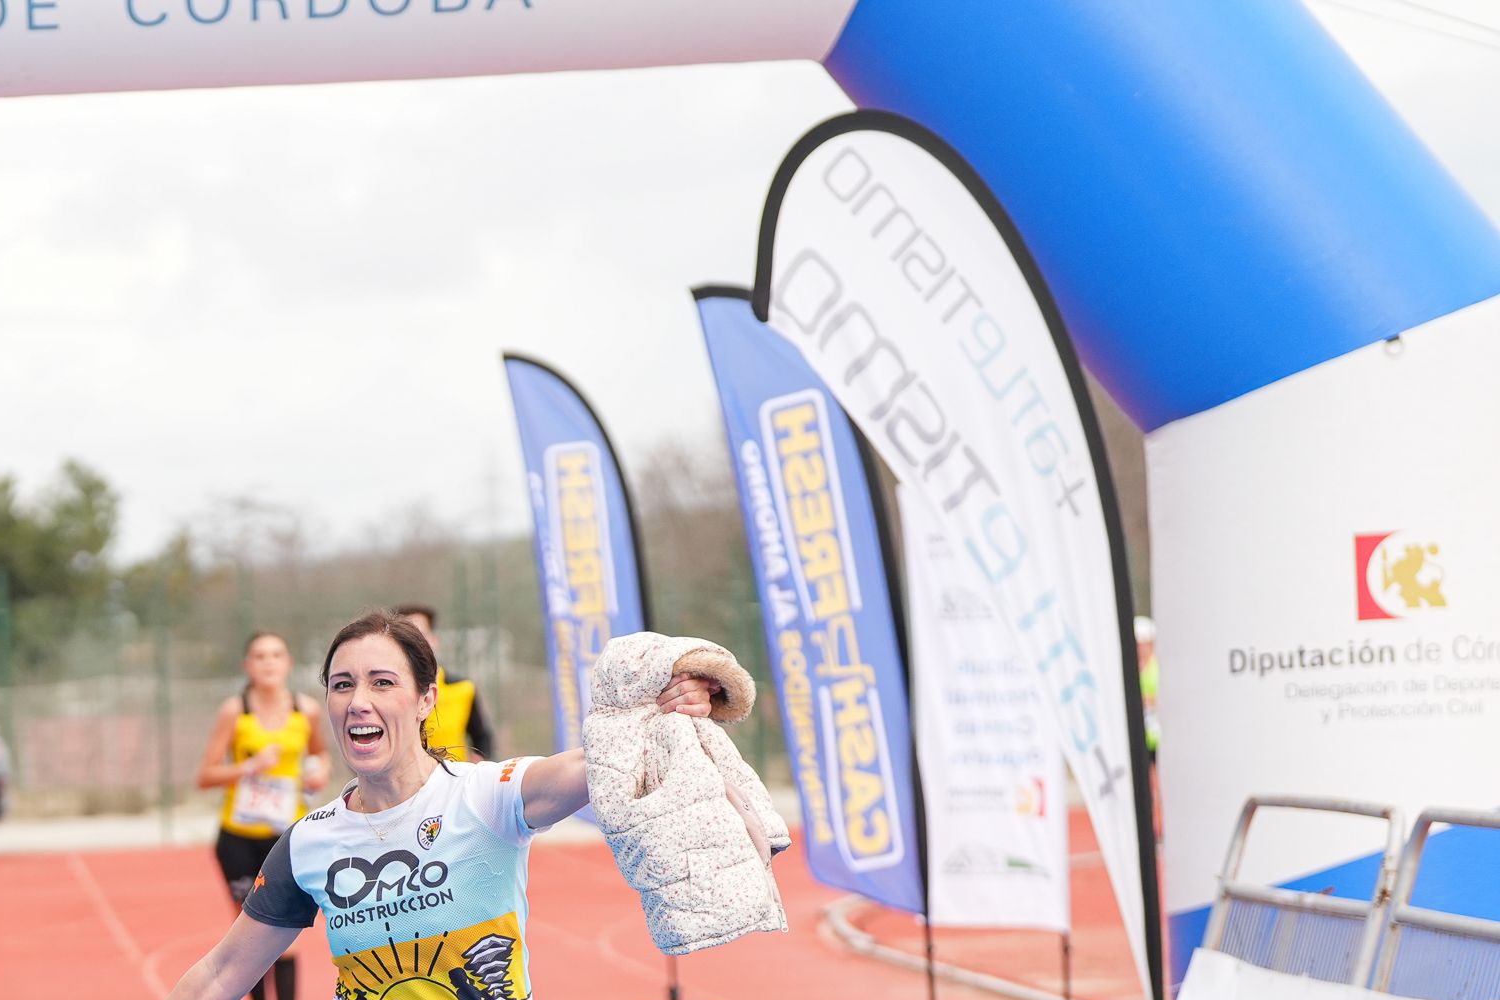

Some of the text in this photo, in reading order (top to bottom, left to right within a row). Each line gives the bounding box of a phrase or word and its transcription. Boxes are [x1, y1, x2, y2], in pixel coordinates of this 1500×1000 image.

[1228, 638, 1396, 677] Diputación
[1403, 638, 1443, 663] de
[329, 888, 454, 930] CONSTRUCCION
